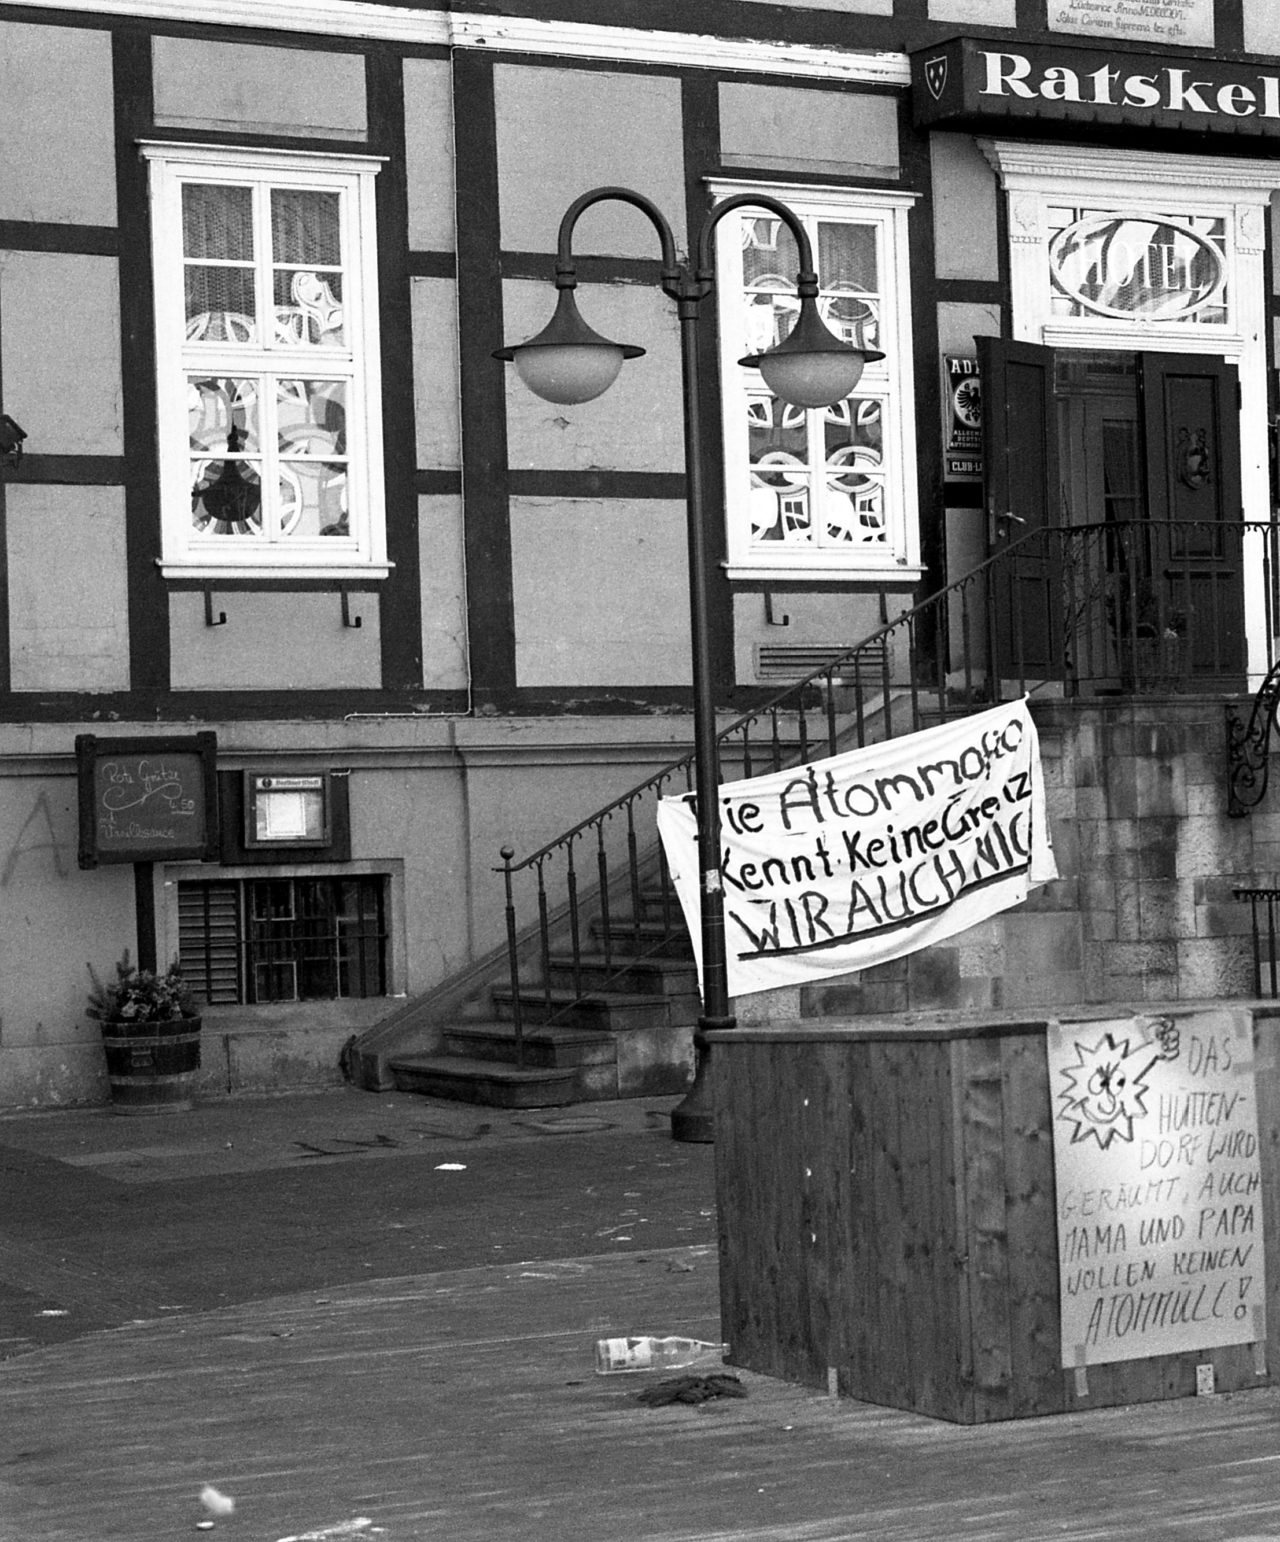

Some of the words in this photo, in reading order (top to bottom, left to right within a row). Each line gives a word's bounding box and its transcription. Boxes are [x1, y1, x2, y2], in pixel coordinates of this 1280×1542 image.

[1077, 238, 1203, 291] HOTEL
[729, 891, 834, 950] WIR
[848, 849, 966, 932] AUCH
[1189, 1035, 1232, 1078] DAS
[1159, 1086, 1246, 1134] HÜTTEN-
[1140, 1133, 1202, 1170] DORF
[1207, 1129, 1256, 1163] WIRD
[1199, 1172, 1260, 1201] AUCH
[1063, 1223, 1126, 1263] MAMA
[1140, 1215, 1184, 1246] UND
[1199, 1205, 1254, 1240] PAPA
[1067, 1261, 1155, 1295] WOLLEN
[1174, 1243, 1254, 1275] KEINEN
